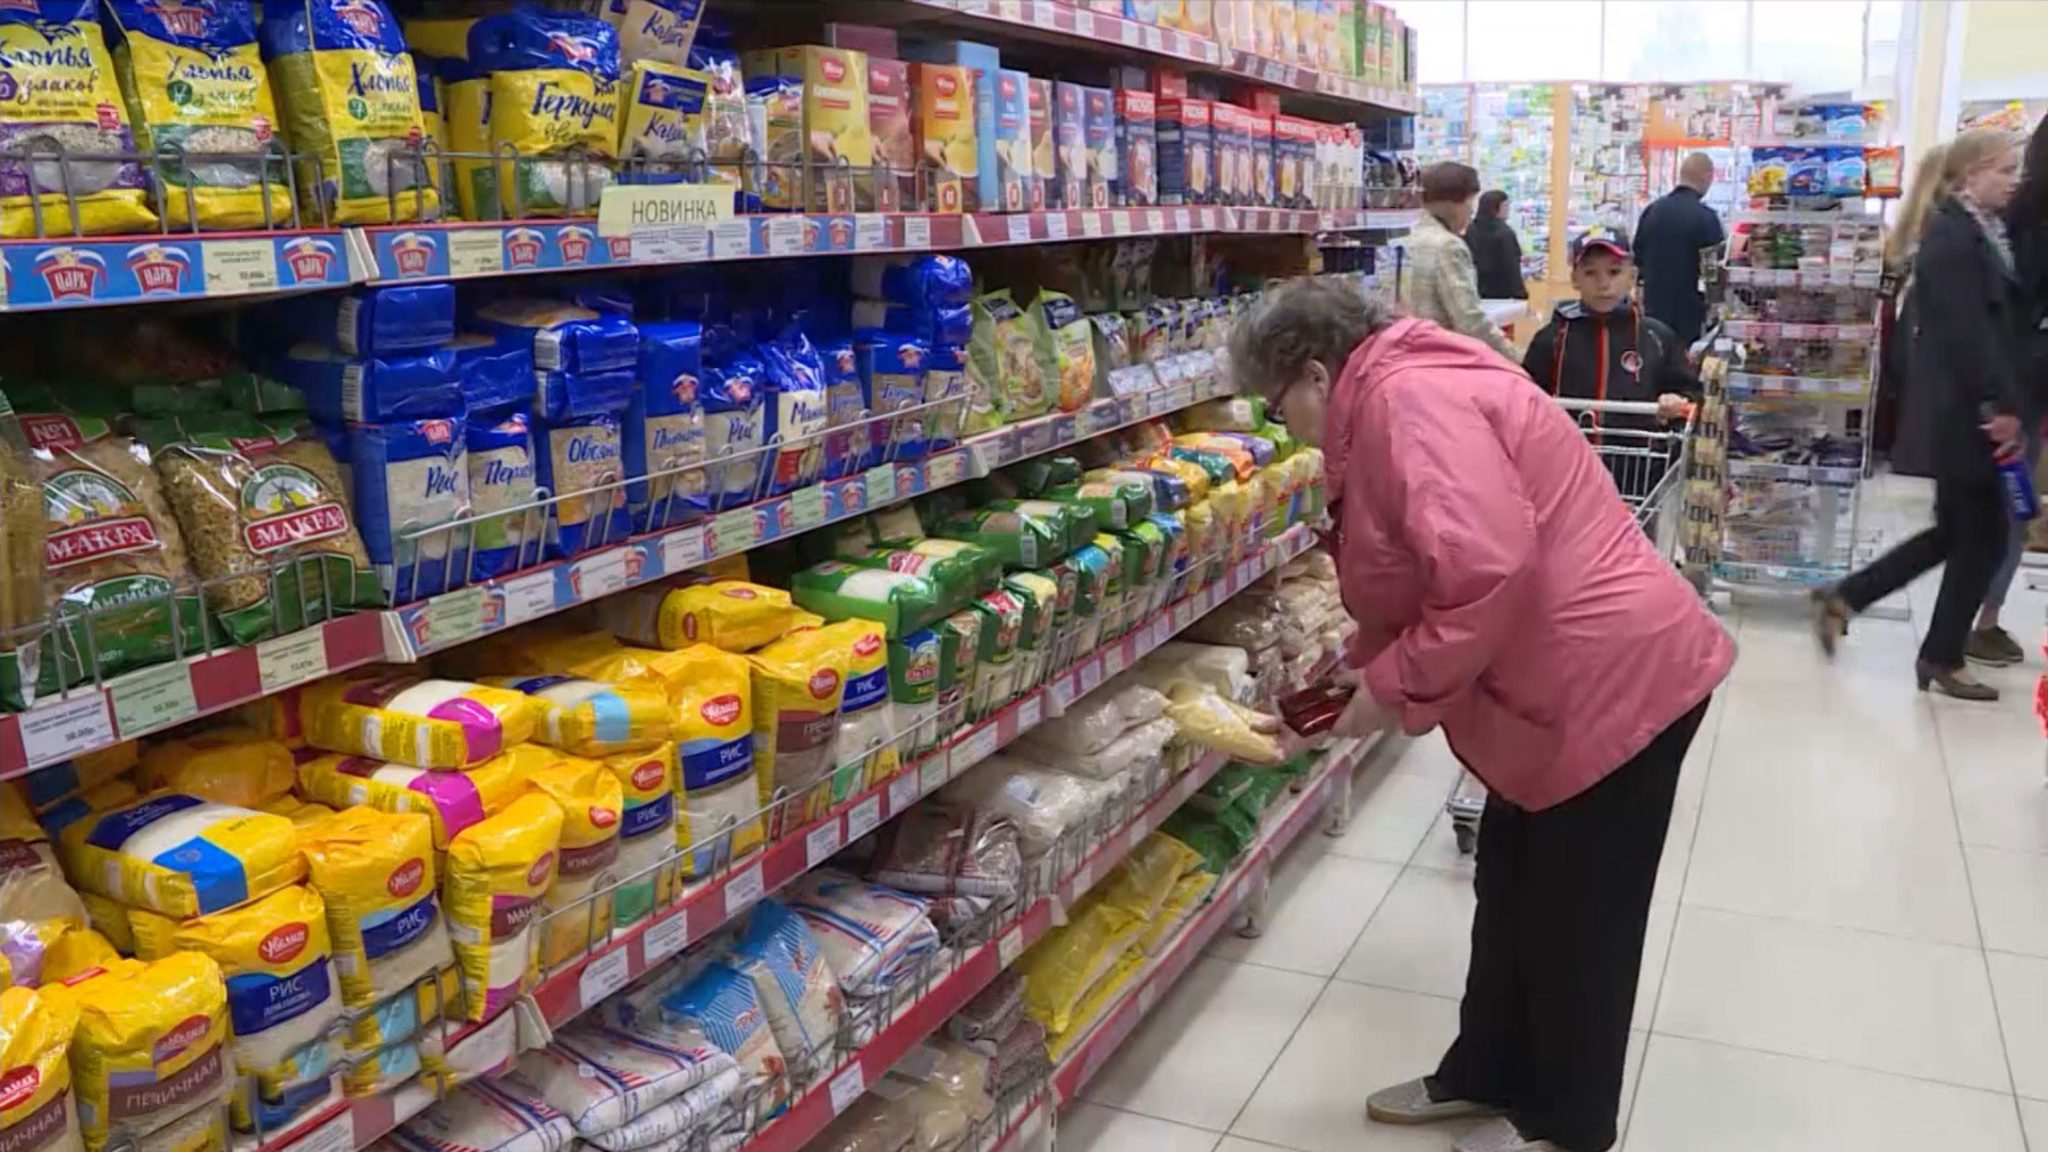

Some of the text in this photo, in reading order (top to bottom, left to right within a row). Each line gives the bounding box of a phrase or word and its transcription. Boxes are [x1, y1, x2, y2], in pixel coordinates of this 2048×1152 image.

[631, 200, 717, 223] НОВИНКА
[425, 465, 458, 498] Рис
[48, 525, 143, 561] MAKFA
[254, 510, 342, 547] MAKFA
[397, 908, 422, 934] РИС
[269, 975, 304, 1003] РИС
